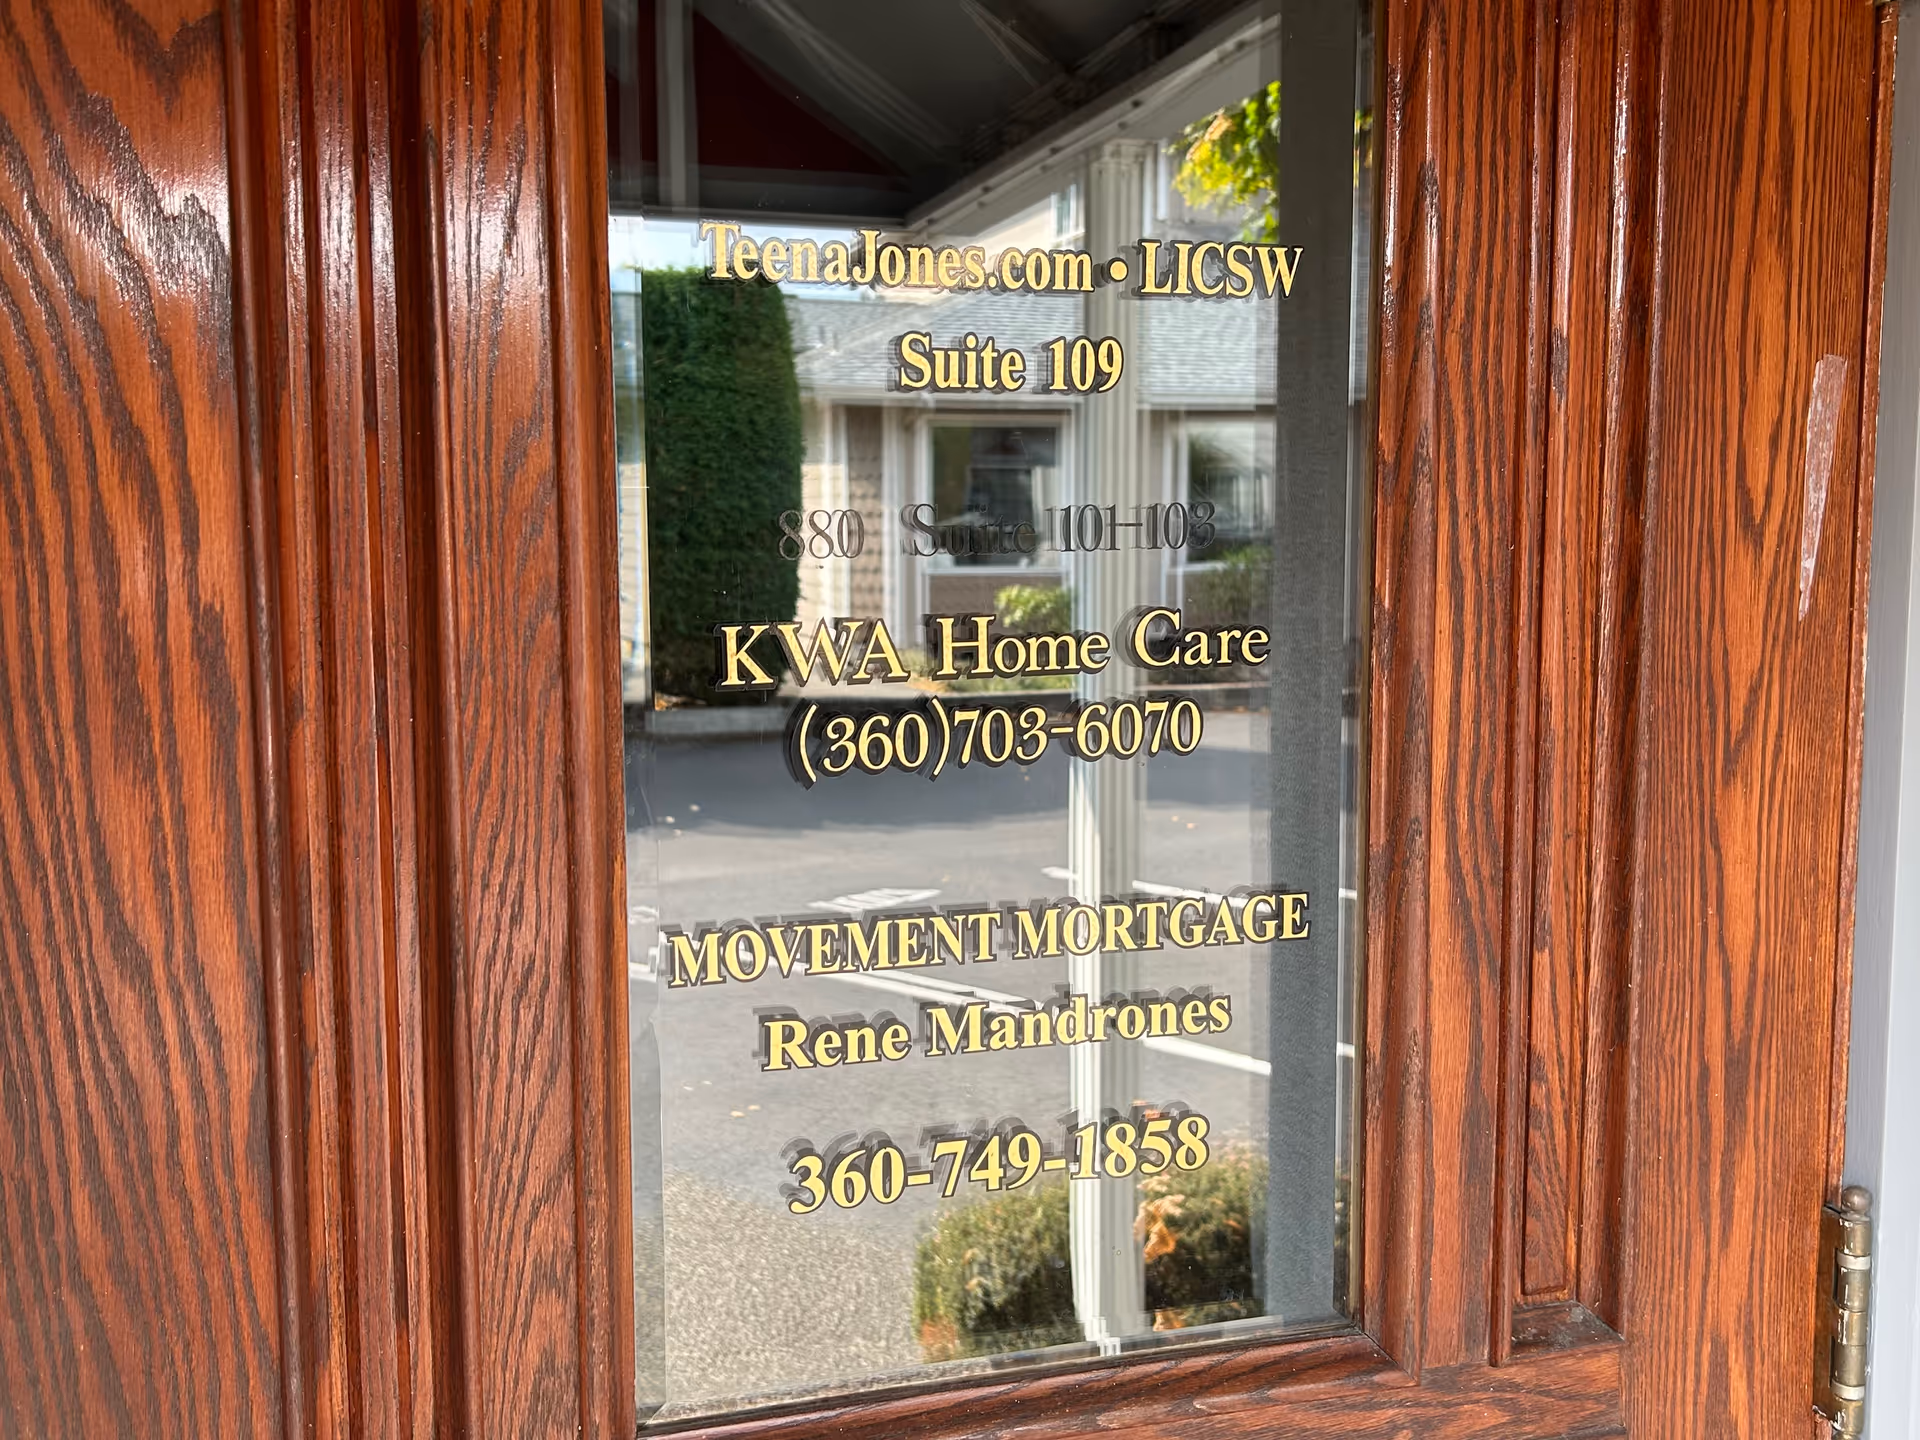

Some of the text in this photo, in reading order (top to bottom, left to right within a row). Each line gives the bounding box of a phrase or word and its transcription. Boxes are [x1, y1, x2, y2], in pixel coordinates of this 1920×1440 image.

[701, 221, 1304, 298] TeenaJones.com LICSW
[899, 331, 1124, 392] Suite 109
[777, 508, 865, 559] 880
[905, 502, 1037, 557] Suite
[718, 607, 1270, 690] KWA Home Care
[799, 697, 1204, 786] (360)703-6070
[668, 891, 1311, 988] MOVEMENT MORTGAGE
[761, 991, 1232, 1072] Rene Mandrones
[787, 1115, 1209, 1214] 360-749-1858
